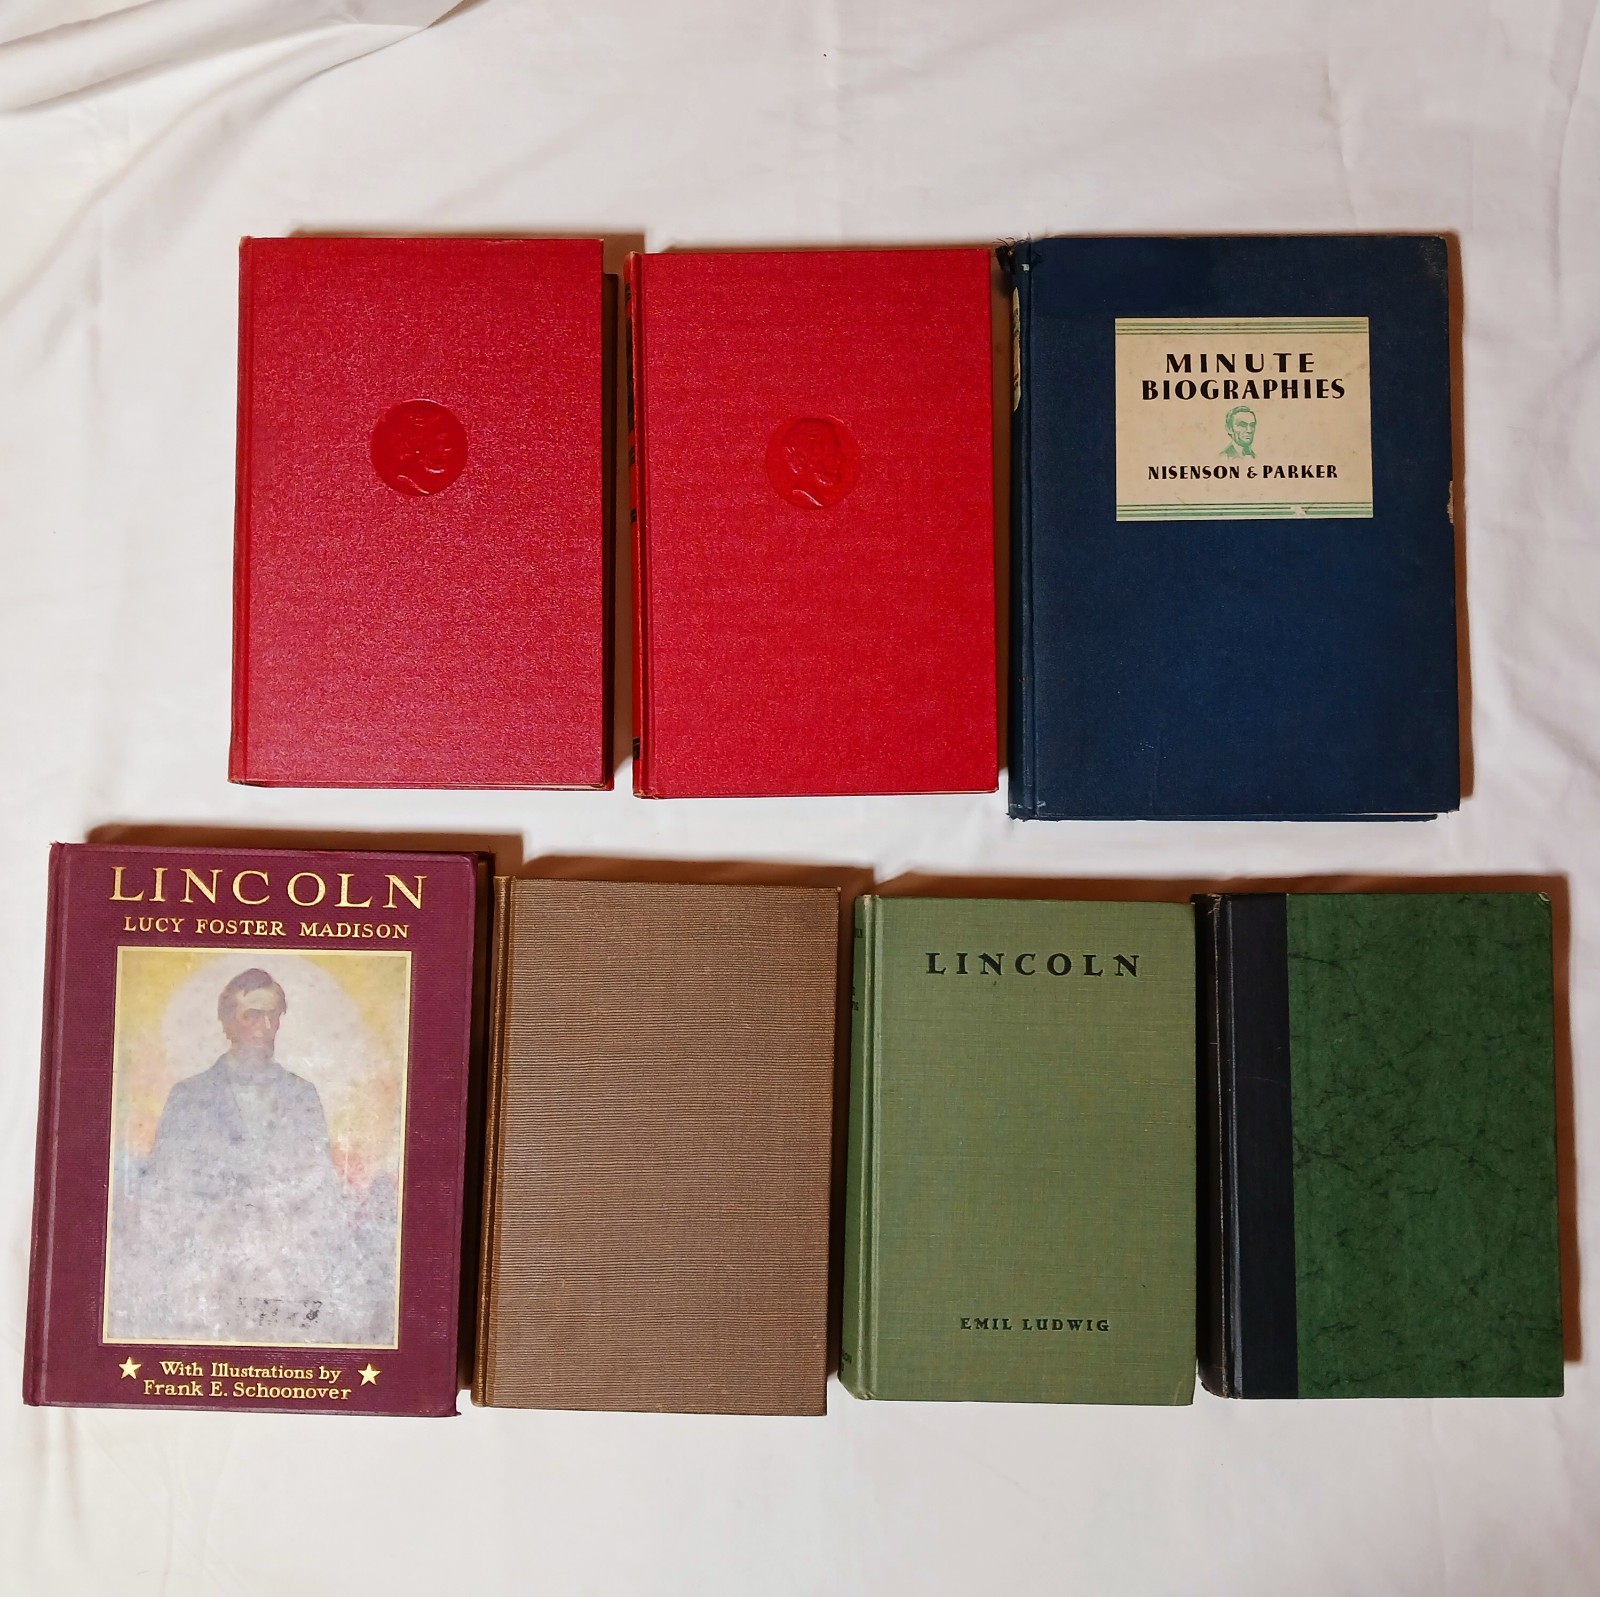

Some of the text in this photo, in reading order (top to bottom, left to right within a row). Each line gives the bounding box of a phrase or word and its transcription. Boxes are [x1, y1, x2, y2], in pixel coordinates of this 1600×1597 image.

[1165, 352, 1315, 374] MINUTE
[1142, 378, 1345, 401] BIOGRAPHIES
[1148, 464, 1338, 481] NISENSON & PARKER
[108, 865, 428, 910] LINCOLN
[123, 916, 410, 939] LUCY FOSTER MADISON
[925, 952, 1140, 978] LINCOLN
[960, 1317, 1110, 1332] EMIL LUDWIG
[159, 1360, 342, 1384] With Illustrations by
[143, 1379, 352, 1401] Frank E. Schoonover
